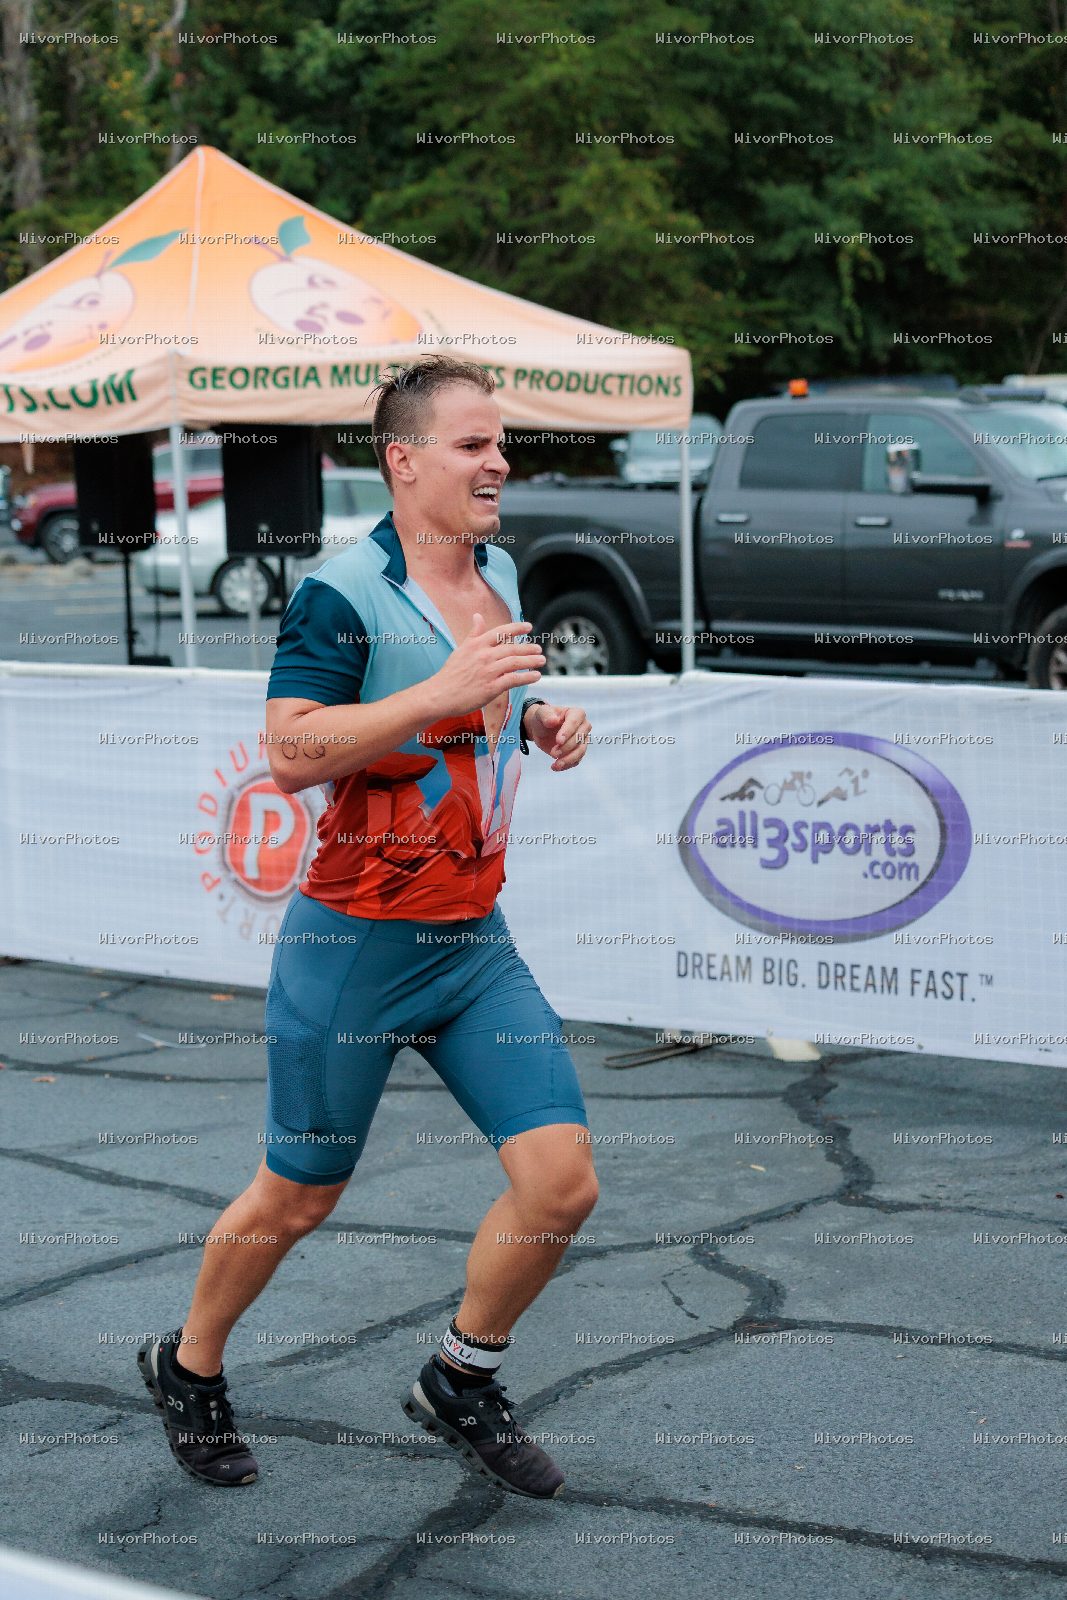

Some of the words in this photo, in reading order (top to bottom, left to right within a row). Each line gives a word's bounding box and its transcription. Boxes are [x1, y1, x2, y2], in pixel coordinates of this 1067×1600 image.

[188, 365, 322, 391] GEORGIA
[514, 367, 683, 397] PRODUCTIONS
[715, 810, 917, 870] all3sports
[676, 951, 752, 984] DREAM
[763, 957, 807, 989] BIG.
[817, 961, 899, 996] DREAM
